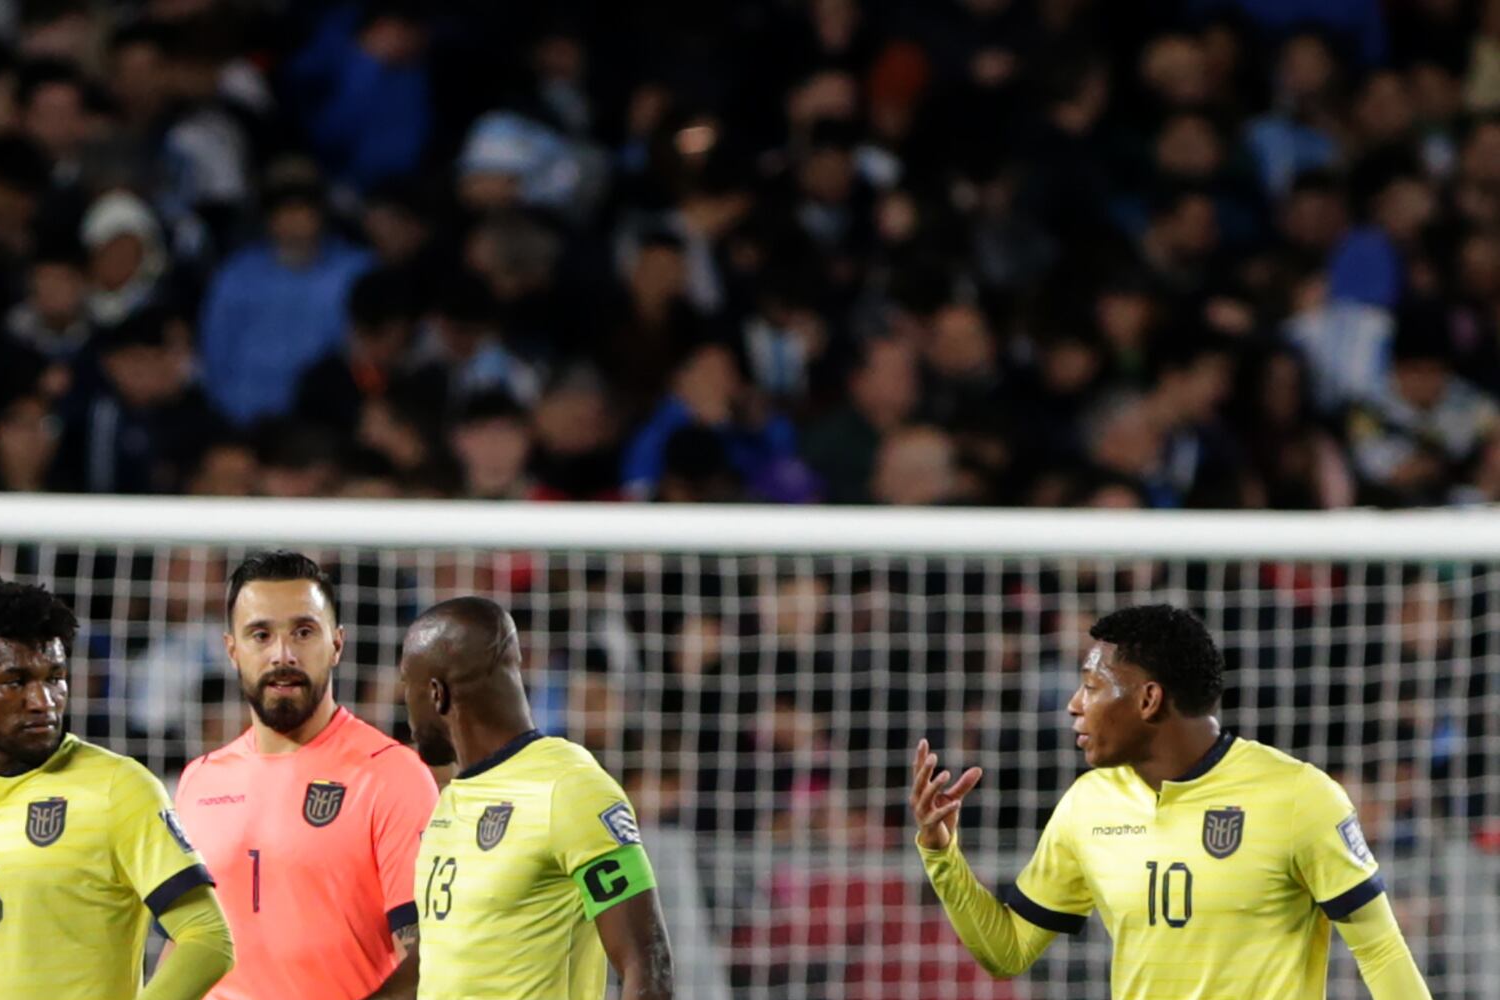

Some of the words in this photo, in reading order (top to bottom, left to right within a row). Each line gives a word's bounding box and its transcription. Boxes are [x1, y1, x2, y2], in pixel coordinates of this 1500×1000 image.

[1092, 824, 1147, 836] marathon
[248, 849, 260, 913] 1
[424, 855, 458, 921] 13
[583, 859, 630, 903] C
[1146, 860, 1193, 929] 10
